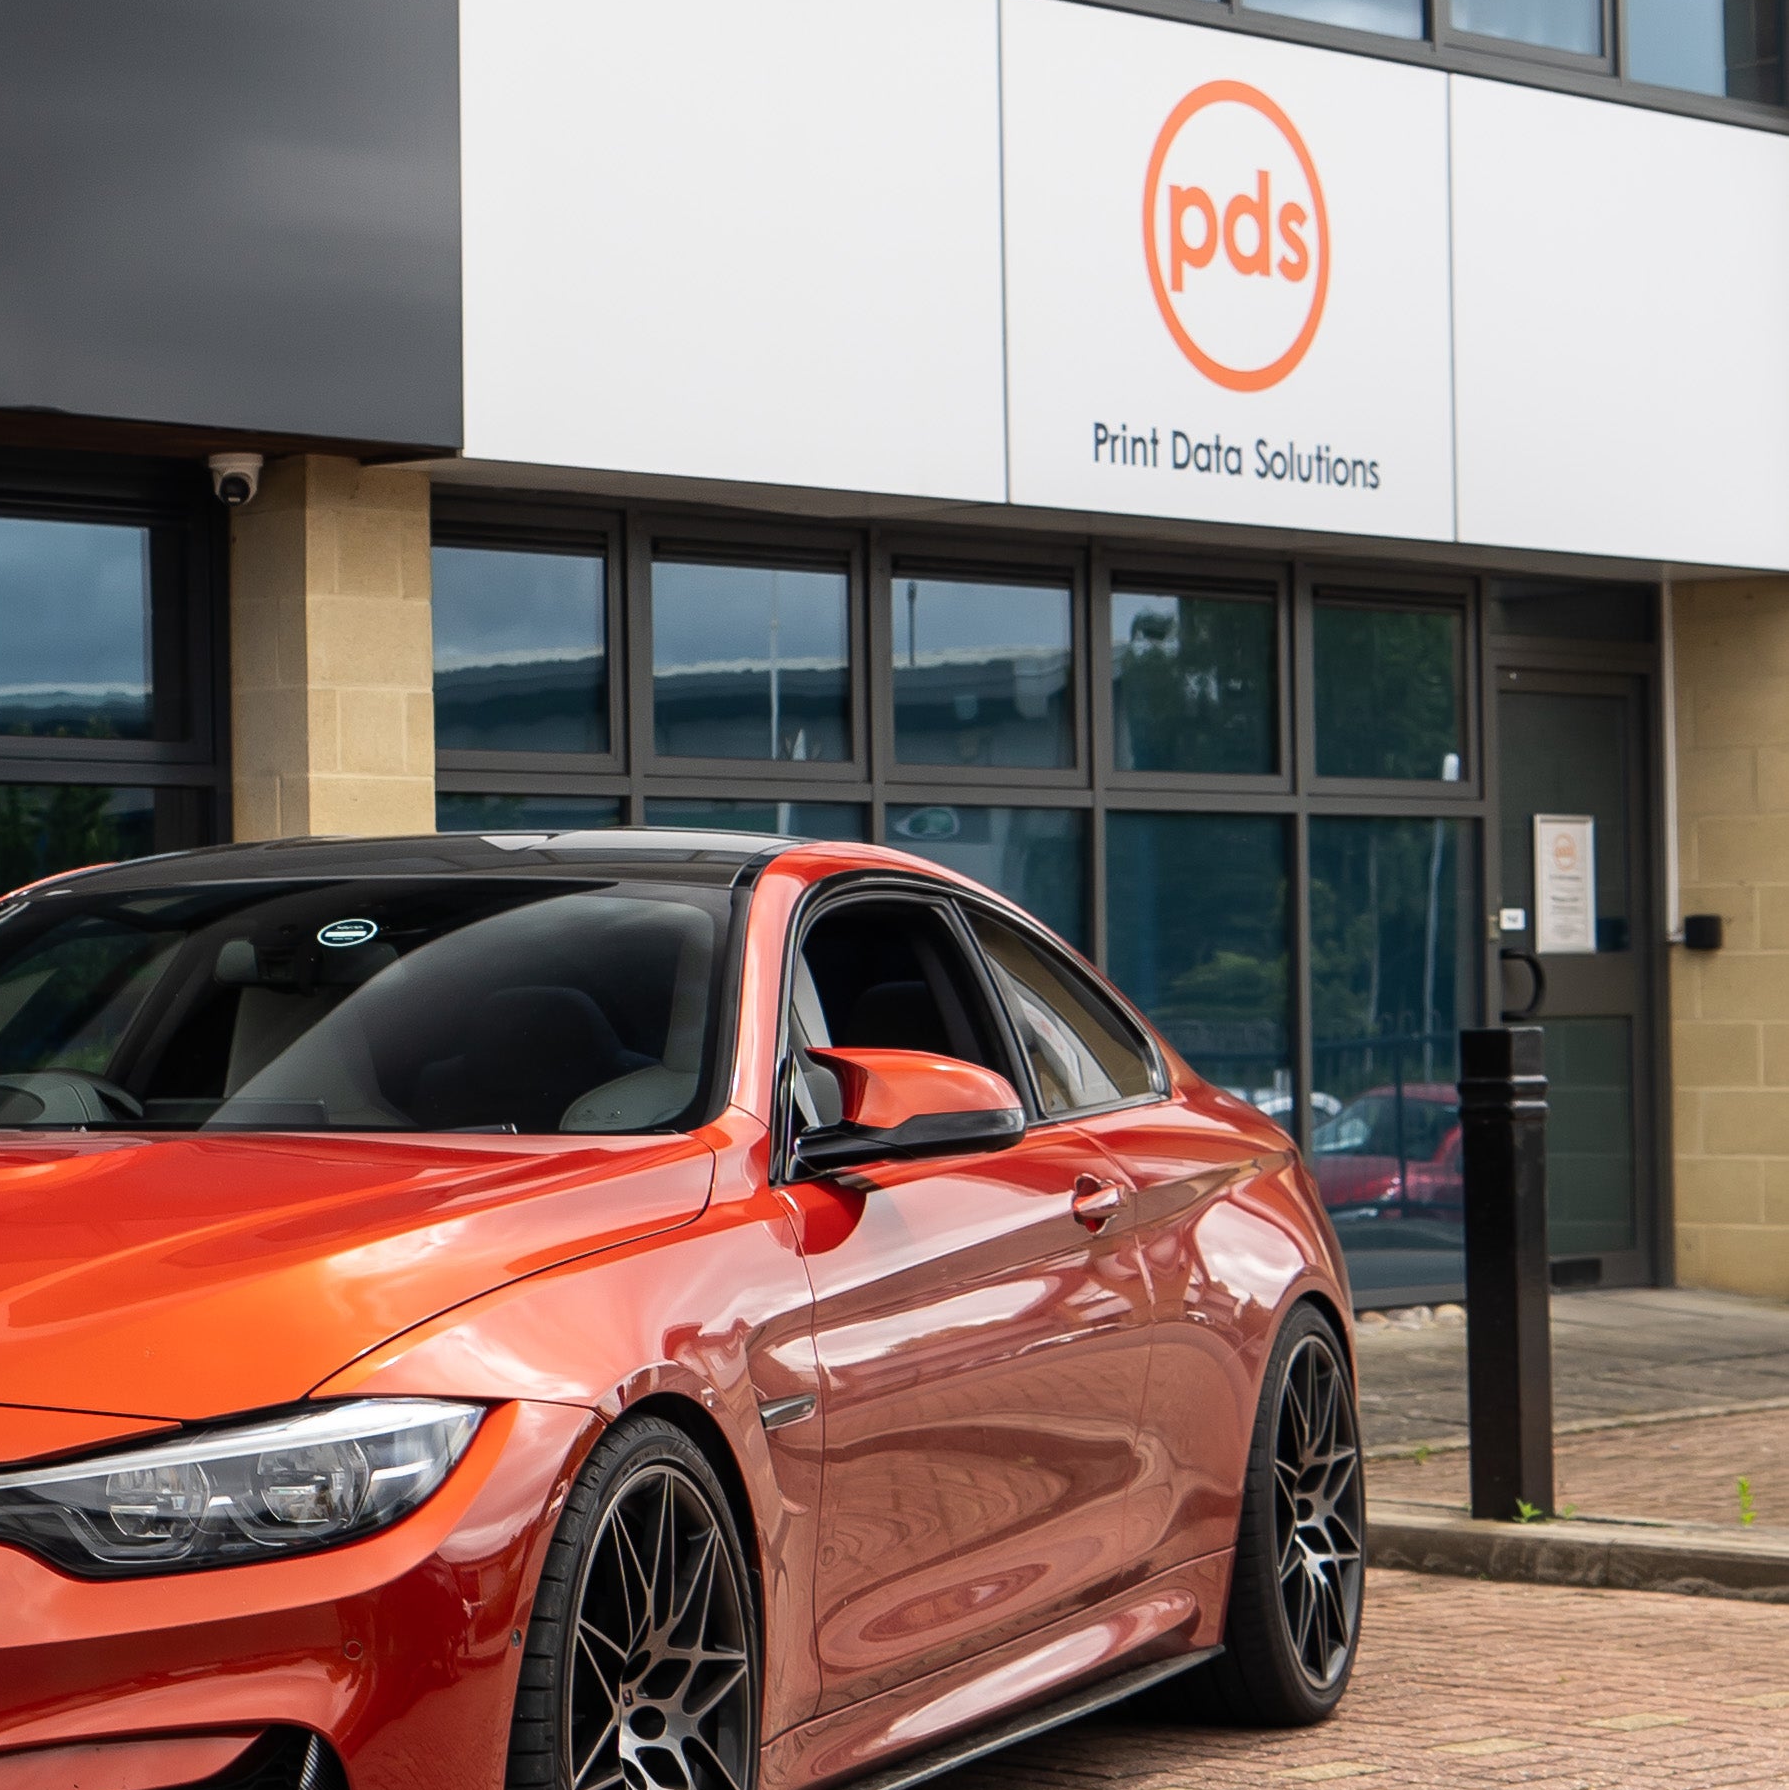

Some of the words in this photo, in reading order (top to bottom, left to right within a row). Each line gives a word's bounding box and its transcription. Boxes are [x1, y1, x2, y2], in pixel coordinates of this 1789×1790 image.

[1169, 169, 1310, 293] pds
[1094, 422, 1159, 468] Print
[1172, 430, 1242, 476] Data
[1256, 438, 1380, 490] Solutions
